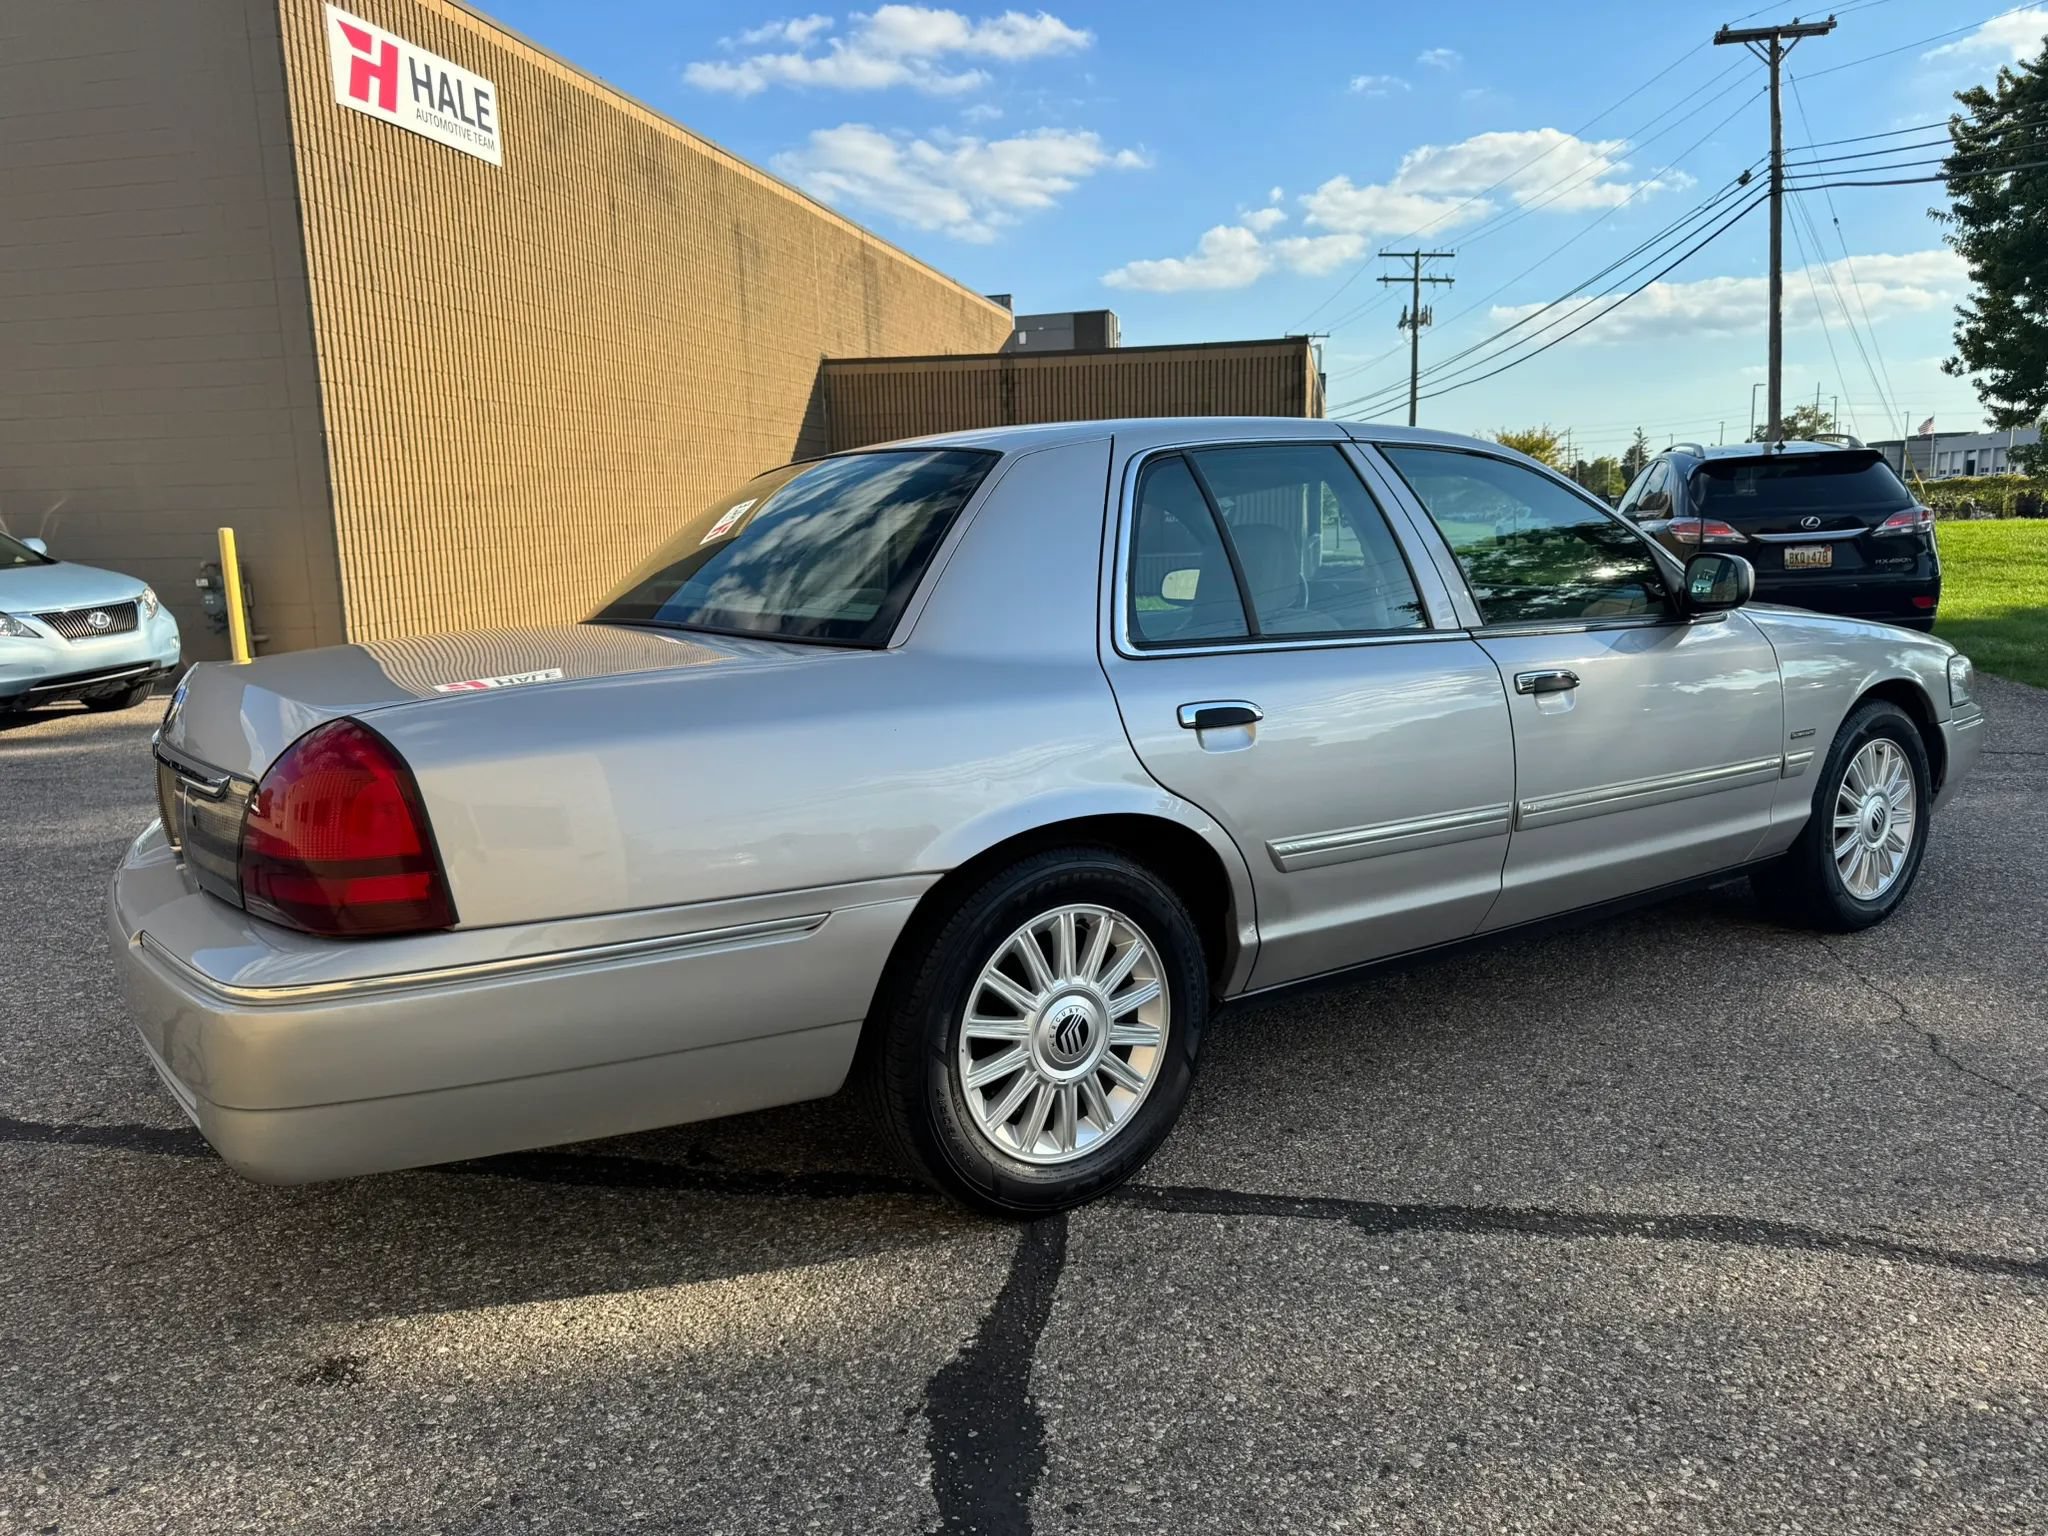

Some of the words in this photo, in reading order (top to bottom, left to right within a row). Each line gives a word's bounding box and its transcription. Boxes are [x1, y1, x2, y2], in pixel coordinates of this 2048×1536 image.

[408, 56, 493, 135] HALE
[416, 107, 473, 142] AUTOMOTIVE
[473, 131, 496, 152] TEAM
